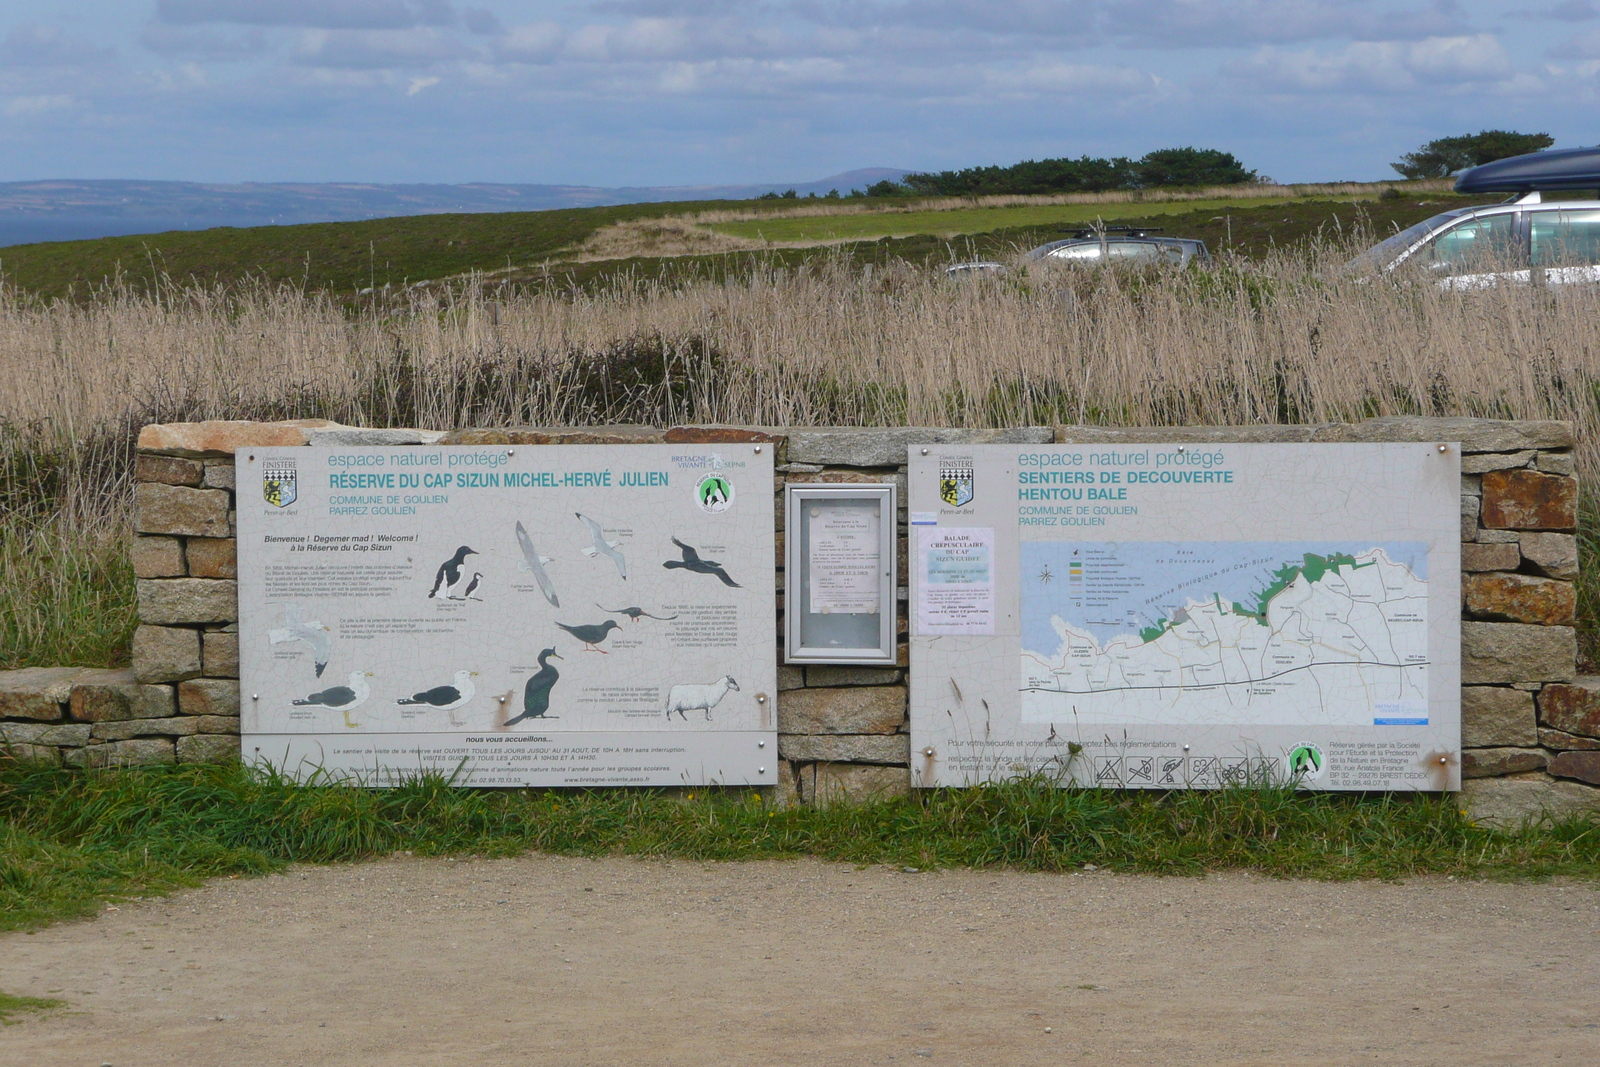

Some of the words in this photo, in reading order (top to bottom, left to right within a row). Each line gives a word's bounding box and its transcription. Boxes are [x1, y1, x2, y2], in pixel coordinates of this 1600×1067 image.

[328, 454, 385, 470] espace
[391, 451, 442, 466] naturel
[448, 450, 507, 469] protégé
[1018, 453, 1083, 469] espace
[1090, 449, 1149, 465] naturel
[1156, 448, 1224, 468] protégé
[329, 471, 395, 489] RÉSERVE
[399, 473, 419, 488] DU
[423, 473, 453, 488] CAP
[456, 472, 500, 488] SIZUN
[504, 470, 611, 487] MICHEL-HERVÉ
[618, 472, 669, 487] JULIEN
[1019, 471, 1095, 483] SENTIERS
[1100, 471, 1121, 483] DE
[1127, 471, 1233, 483] DECOUVERTE
[1019, 488, 1082, 500] HENTOU
[1088, 488, 1127, 500] BALE
[329, 495, 382, 505] COMMUNE
[386, 495, 400, 504] DE
[403, 495, 448, 504] GOULIEN
[329, 507, 368, 515] PARREZ
[371, 506, 416, 515] GOULIEN
[1019, 506, 1072, 515] COMMUNE
[1076, 506, 1090, 514] DE
[1093, 506, 1138, 514] GOULIEN
[1019, 517, 1057, 526] PARREZ
[1060, 517, 1105, 525] GOULIEN
[264, 535, 304, 543] Bienvenue
[313, 535, 350, 544] Degemer
[352, 535, 369, 543] mad
[377, 534, 414, 542] Welcome
[306, 544, 338, 552] Réserve
[352, 544, 368, 552] Cap
[370, 544, 392, 552] Sizun
[1145, 588, 1174, 604] Réserve
[1178, 571, 1218, 589] Biologique
[1234, 556, 1274, 570] Cap-Sizun
[1120, 741, 1176, 749] réglementations
